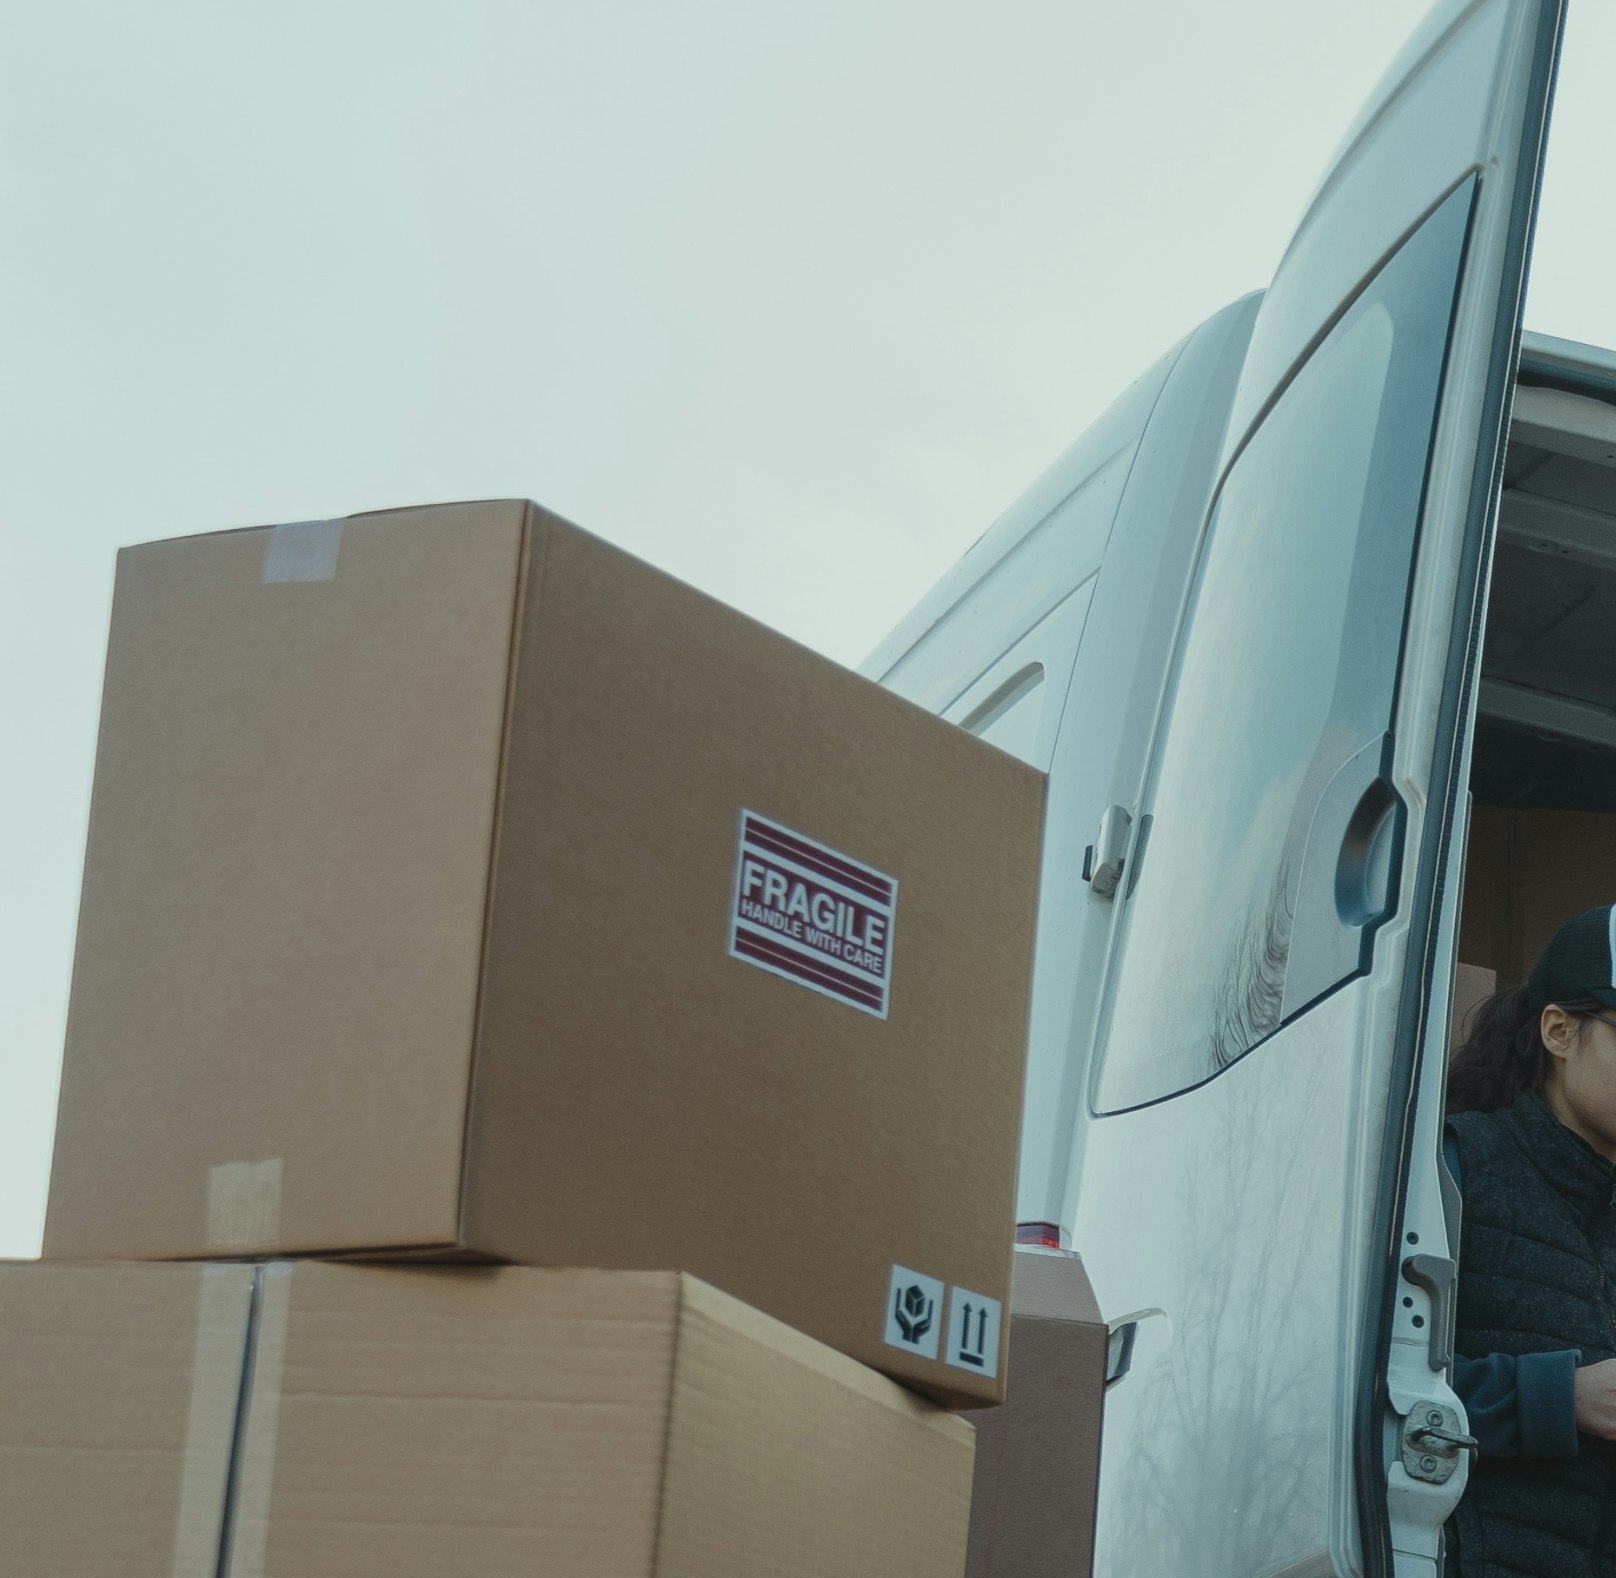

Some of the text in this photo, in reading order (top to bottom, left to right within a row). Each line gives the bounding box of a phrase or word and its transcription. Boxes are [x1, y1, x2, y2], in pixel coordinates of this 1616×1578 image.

[741, 899, 882, 974] HANDLE WITH CARE
[742, 860, 885, 956] FRAGILE
